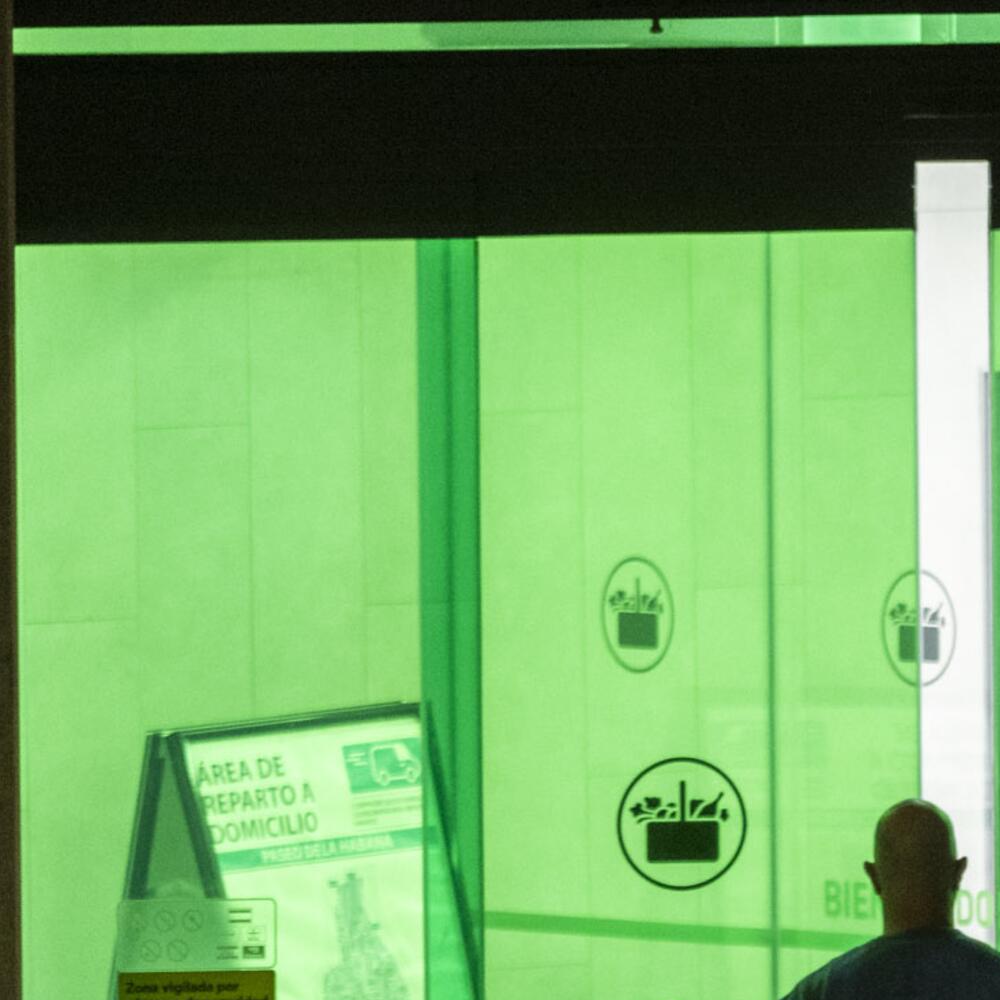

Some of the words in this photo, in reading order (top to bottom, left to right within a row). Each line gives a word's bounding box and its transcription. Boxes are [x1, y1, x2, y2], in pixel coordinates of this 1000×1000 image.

[257, 756, 285, 779] DE
[202, 785, 296, 815] REPARTO
[302, 782, 316, 803] A
[209, 812, 318, 845] DOMICILIO
